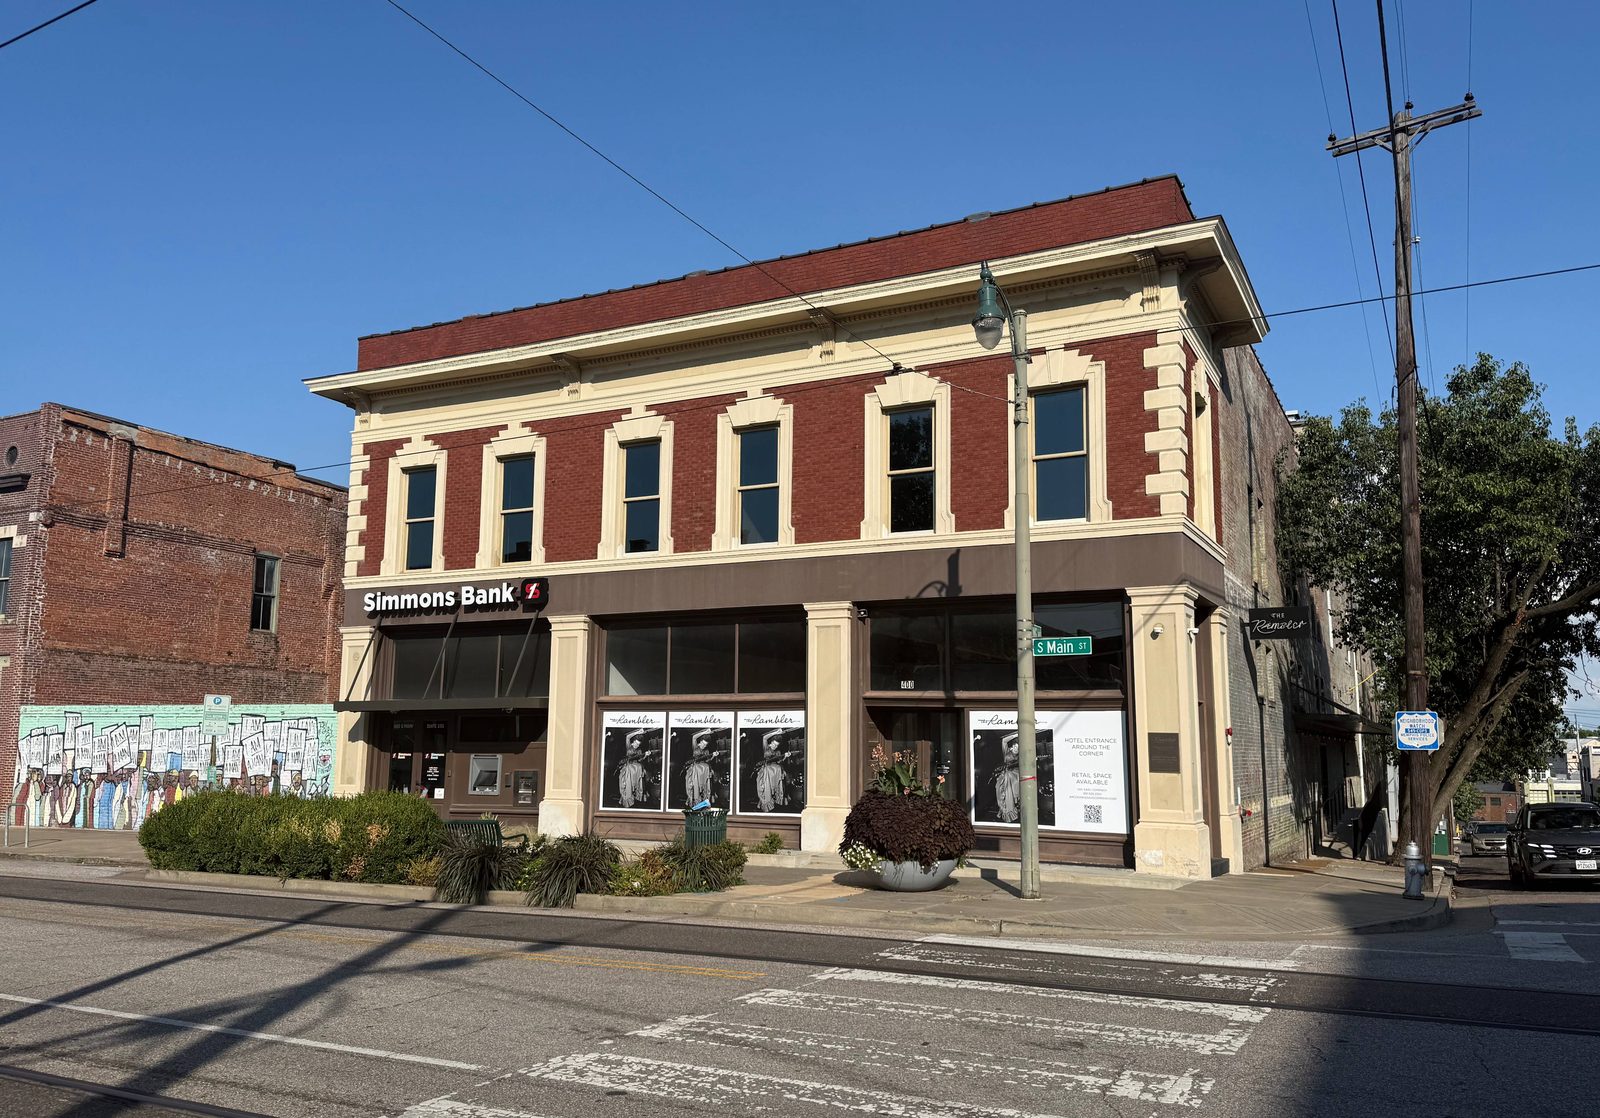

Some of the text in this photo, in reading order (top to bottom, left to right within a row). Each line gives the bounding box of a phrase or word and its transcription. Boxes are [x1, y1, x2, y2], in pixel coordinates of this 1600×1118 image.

[363, 590, 456, 612] Simmons
[461, 582, 515, 606] Bank
[1037, 641, 1043, 653] S
[1047, 640, 1074, 654] Main
[616, 714, 655, 724] Rambler
[682, 714, 722, 724] Rambler
[751, 714, 793, 724] Rambler
